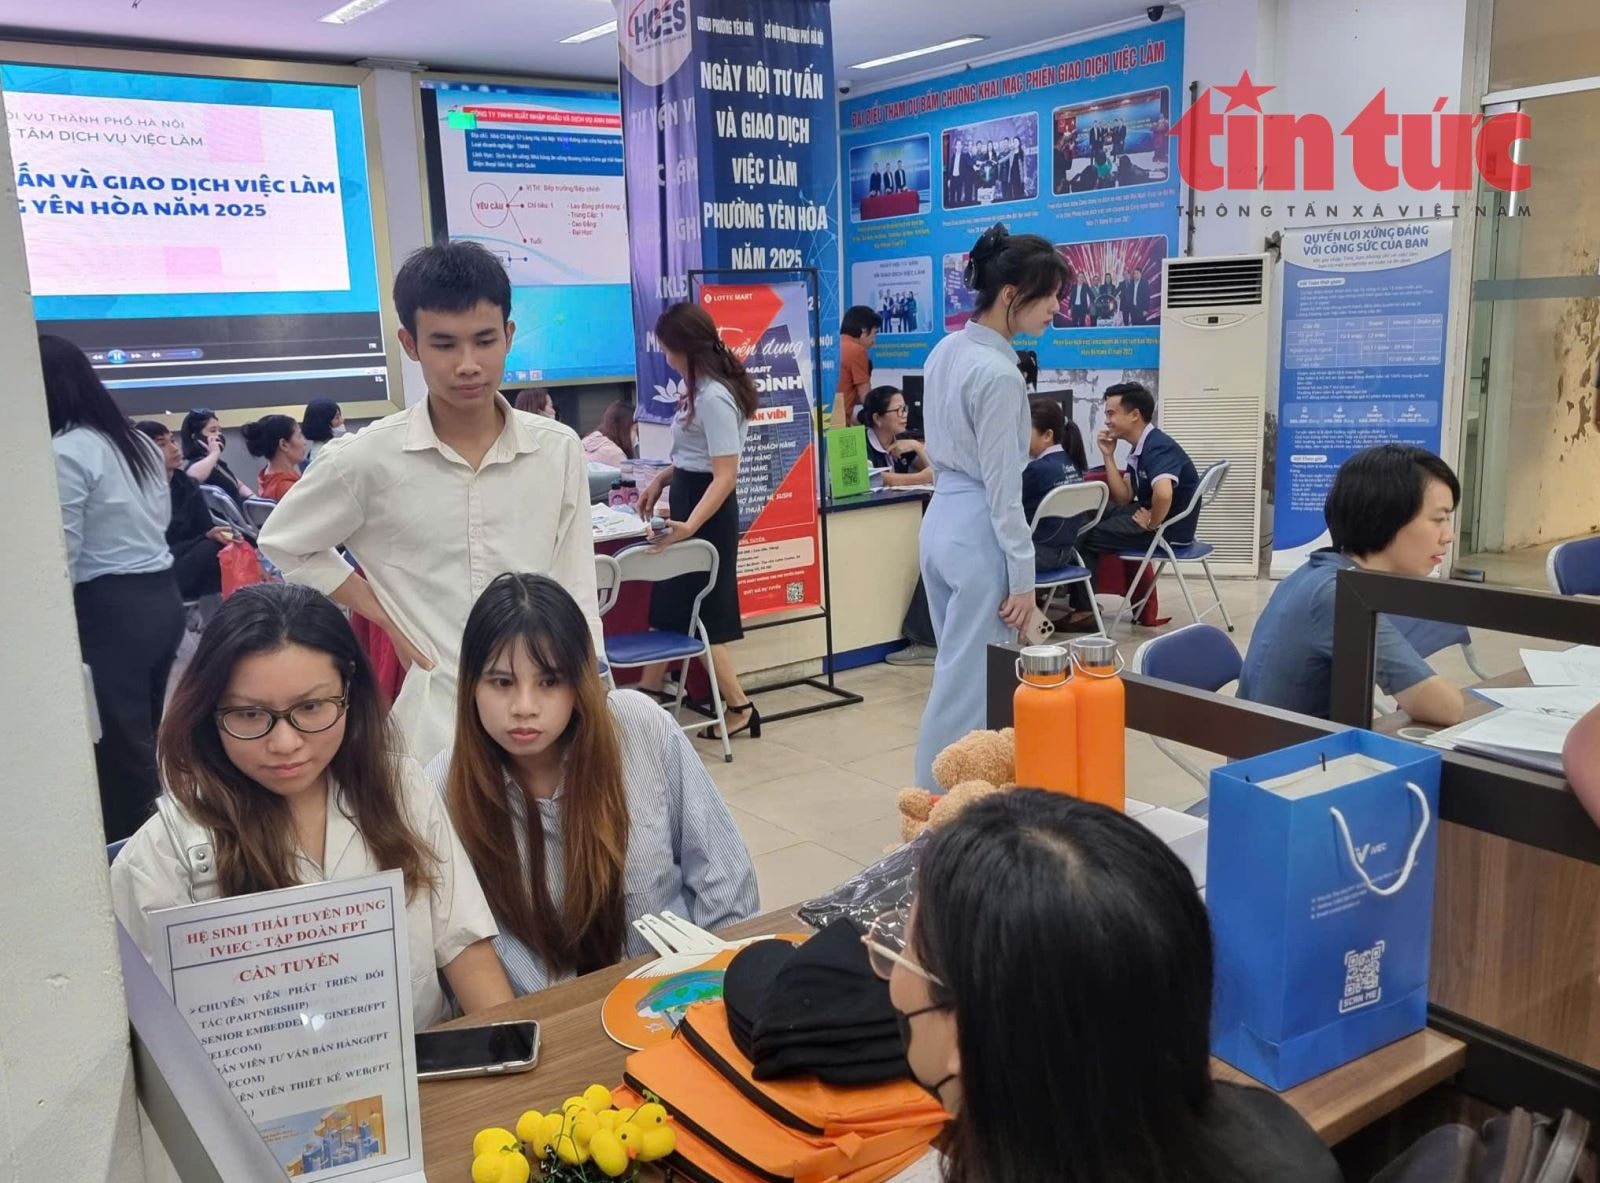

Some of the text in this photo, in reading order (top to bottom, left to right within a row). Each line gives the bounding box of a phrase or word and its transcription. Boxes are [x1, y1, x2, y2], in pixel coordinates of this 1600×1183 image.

[700, 58, 823, 99] NGÀY HỘI TƯ VẤN
[884, 102, 905, 121] THAM
[978, 77, 998, 101] KHAI
[1001, 75, 1023, 98] MẠC
[1026, 64, 1055, 92] PHIÊN
[1058, 59, 1081, 84] GIAO
[1084, 54, 1110, 81] DỊCH
[1113, 44, 1137, 74] VIỆC
[1140, 39, 1165, 66] LÀM
[49, 112, 99, 124] THÀNH
[104, 112, 133, 125] PHỐ
[138, 117, 156, 127] HÀ
[716, 106, 737, 138] VÀ
[741, 112, 774, 139] GIAO
[778, 115, 809, 148] DỊCH
[16, 127, 54, 140] TÂM
[59, 130, 99, 144] DỊCH
[103, 132, 127, 144] VỤ
[130, 133, 167, 146] VIỆC
[170, 133, 203, 146] LÀM
[17, 163, 336, 197] ẤN VÀ GIAO DỊCH VIỆC LÀM
[732, 152, 798, 190] VIỆC LÀM
[32, 195, 84, 214] YÊN
[91, 196, 149, 215] HÒA
[154, 196, 210, 216] NĂM
[215, 203, 266, 217] 2025
[476, 202, 489, 210] YÊU
[703, 196, 828, 231] PHƯỜNG YÊN HÒA
[1343, 230, 1360, 241] LỢI
[1362, 227, 1395, 240] XỨNG
[1397, 224, 1429, 236] ĐÁNG
[731, 242, 766, 270] NĂM
[1304, 237, 1428, 256] VỚI CÔNG SỨC CỦA BẠN
[713, 293, 752, 302] LOTTE MART
[762, 338, 804, 360] dụng
[745, 366, 772, 374] MART
[767, 409, 787, 420] VIÊN
[758, 443, 778, 451] KHÁCH
[780, 441, 796, 449] HÀNG
[186, 899, 386, 947] HỆ SINH THÁI TUYỂN DỤNG
[209, 940, 253, 957] IVIEC
[264, 933, 293, 950] TẬP
[297, 924, 338, 942] ĐOÀN
[341, 918, 369, 934] FPT
[239, 951, 340, 983] CẦN TUYỂN
[198, 970, 385, 1015] CHUYÊN VIÊN PHÁT TRIỂN ĐỐI
[1344, 989, 1377, 1008] SCAN ME
[200, 1002, 309, 1030] TÁC (PARTNERSHIP)
[201, 1029, 243, 1046] SENIOR
[322, 1001, 387, 1021] GINEER(FPT
[210, 1043, 262, 1061] ELECOM)
[240, 1057, 266, 1071] VIÊN
[268, 1051, 286, 1065] TƯ
[287, 1047, 312, 1061] VẤN
[312, 1040, 334, 1055] BÁN
[336, 1031, 390, 1050] HÀNG(FPT
[228, 1074, 265, 1090] ECOM)
[259, 1084, 286, 1098] VIÊN
[288, 1077, 323, 1092] THIẾT
[326, 1071, 342, 1084] KẾ
